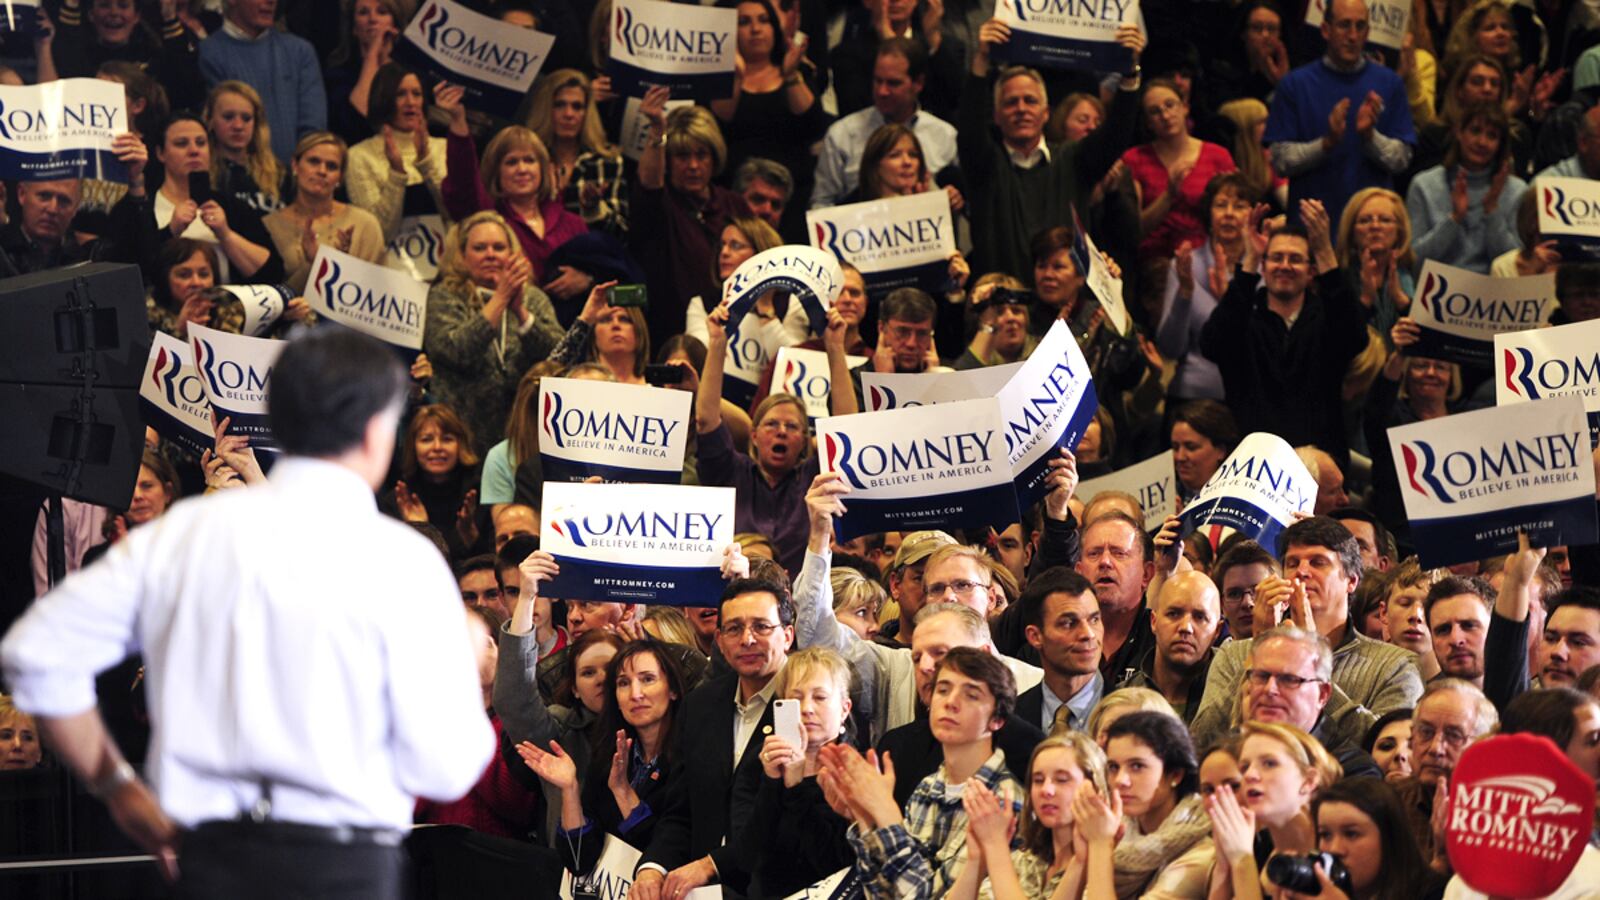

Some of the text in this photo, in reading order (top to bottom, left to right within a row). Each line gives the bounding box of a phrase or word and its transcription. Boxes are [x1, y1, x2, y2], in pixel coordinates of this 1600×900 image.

[616, 5, 730, 57] ROMNEY
[1031, 15, 1066, 25] BELIEVE
[1069, 19, 1079, 27] IN
[418, 2, 539, 75] ROMNEY
[440, 47, 521, 81] BELIEVE IN AMERICA
[637, 50, 721, 64] BELIEVE IN AMERICA
[16, 133, 55, 142] BELIEV
[815, 216, 944, 263] ROMNEY
[852, 243, 943, 263] BELIEVE IN AMERICA
[313, 256, 424, 329] ROMNEY
[1420, 271, 1548, 325] ROMNEY
[338, 306, 375, 325] BELIEVE
[375, 318, 387, 330] IN
[1448, 317, 1539, 331] BELIEVE IN AMERICA
[152, 345, 213, 409] RO
[180, 402, 210, 422] BELIE
[543, 391, 681, 449] ROMNEY
[1042, 421, 1054, 434] IN
[566, 439, 668, 459] BELIEVE IN AMERICA
[825, 429, 996, 490] ROMNEY
[870, 464, 993, 489] BELIEVE IN AMERICA
[1400, 431, 1581, 505] ROMNEY
[1244, 480, 1257, 490] IN
[1458, 470, 1580, 501] BELIEVE IN AMERICA
[884, 505, 965, 520] MITTROMNEY.COM
[550, 507, 724, 548] ROMNEY
[591, 538, 714, 553] BELIEVE IN AMERICA
[594, 577, 676, 590] MITTROMNEY.COM
[1454, 783, 1538, 818] MITT
[1450, 807, 1579, 851] ROMNEY
[1456, 833, 1564, 862] FOR PRESIDENT
